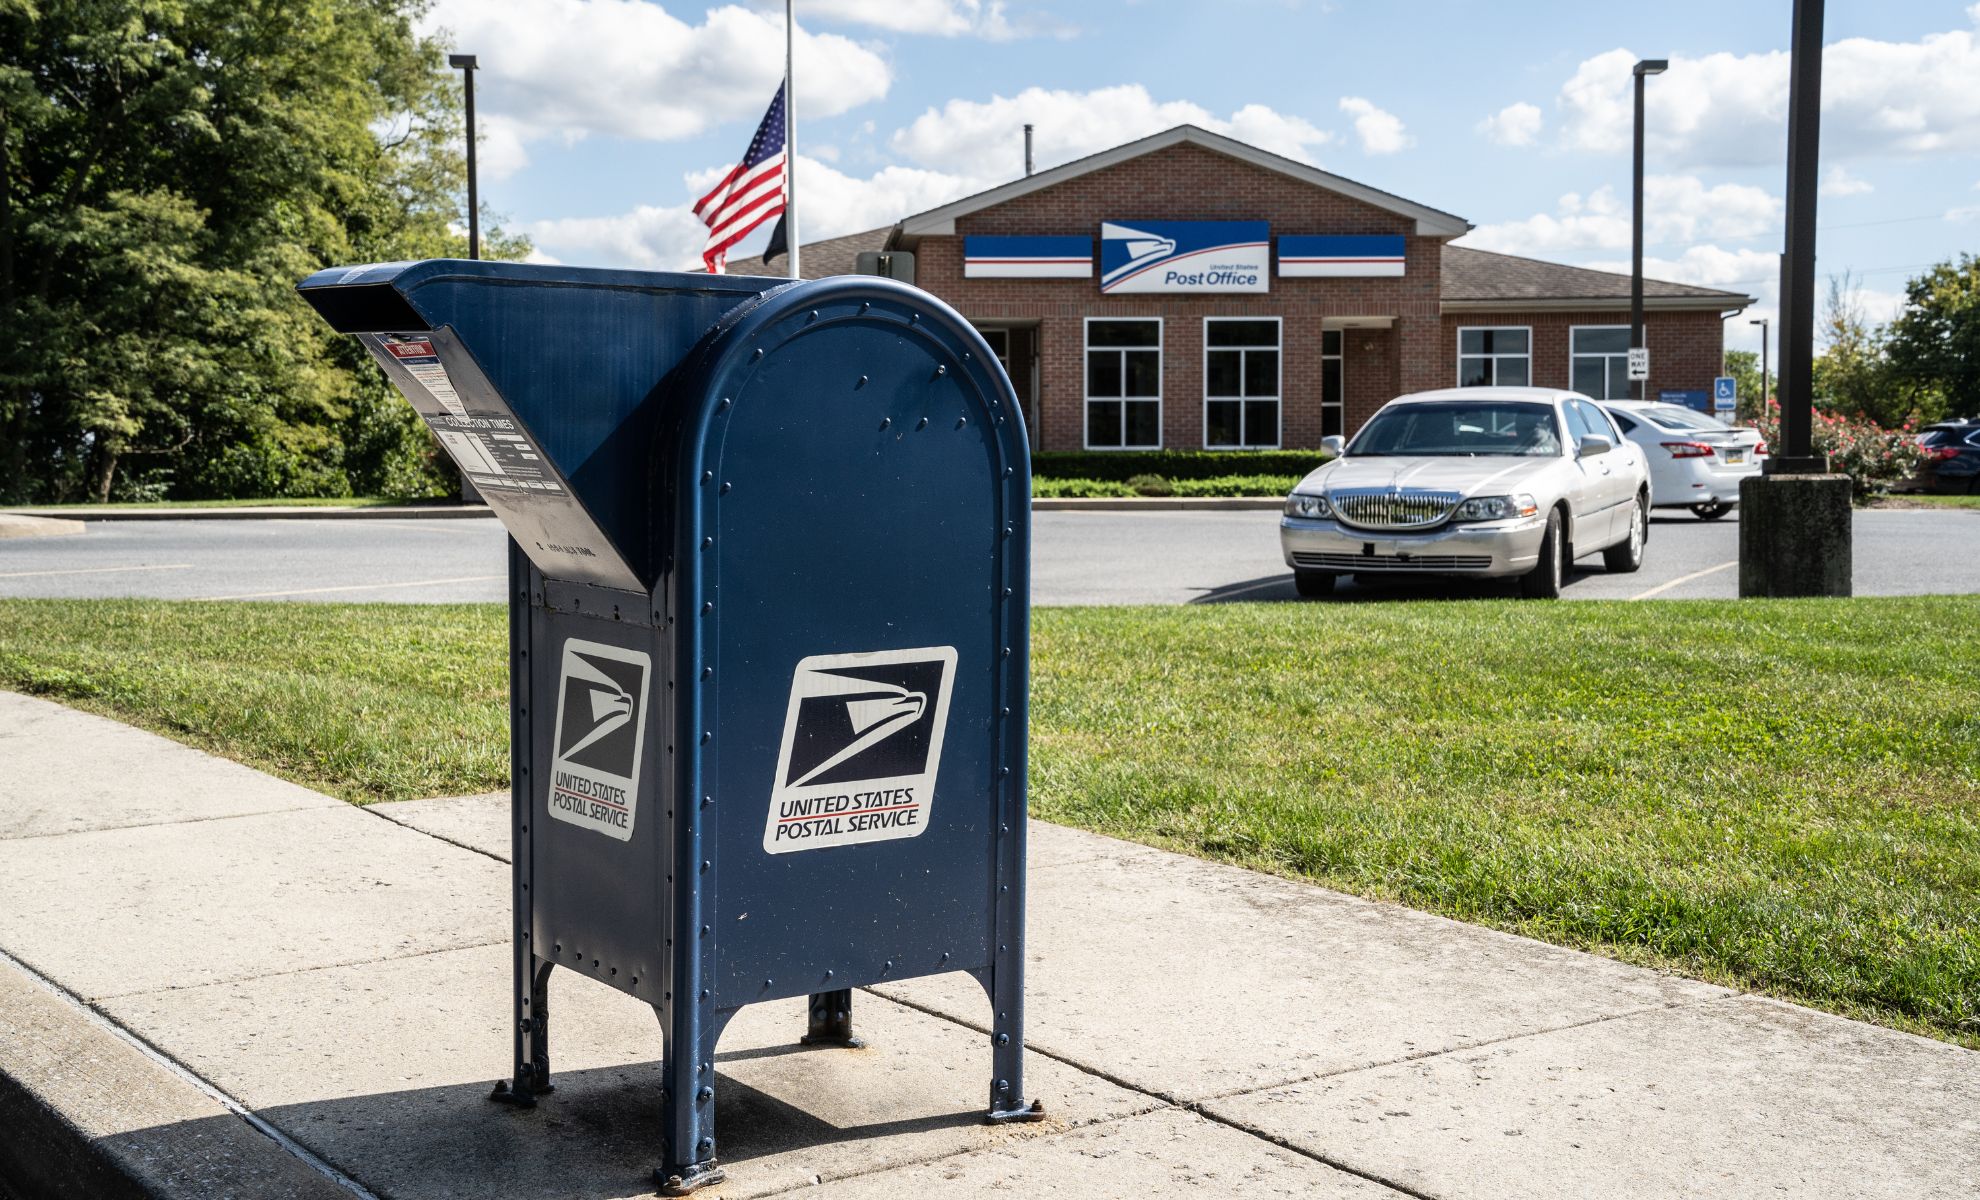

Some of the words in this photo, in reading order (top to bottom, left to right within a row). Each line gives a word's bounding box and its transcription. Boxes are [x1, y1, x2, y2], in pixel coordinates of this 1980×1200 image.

[1165, 271, 1204, 285] Post
[1206, 271, 1257, 285] Office
[489, 419, 514, 430] TIMES
[556, 771, 591, 794] UNITED
[592, 782, 626, 805] STATES
[780, 795, 849, 818] UNITED
[852, 788, 914, 810] STATES
[554, 792, 588, 816] POSTAL
[589, 803, 628, 829] SERVICE
[776, 818, 843, 841] POSTAL
[847, 809, 919, 832] SERVICE
